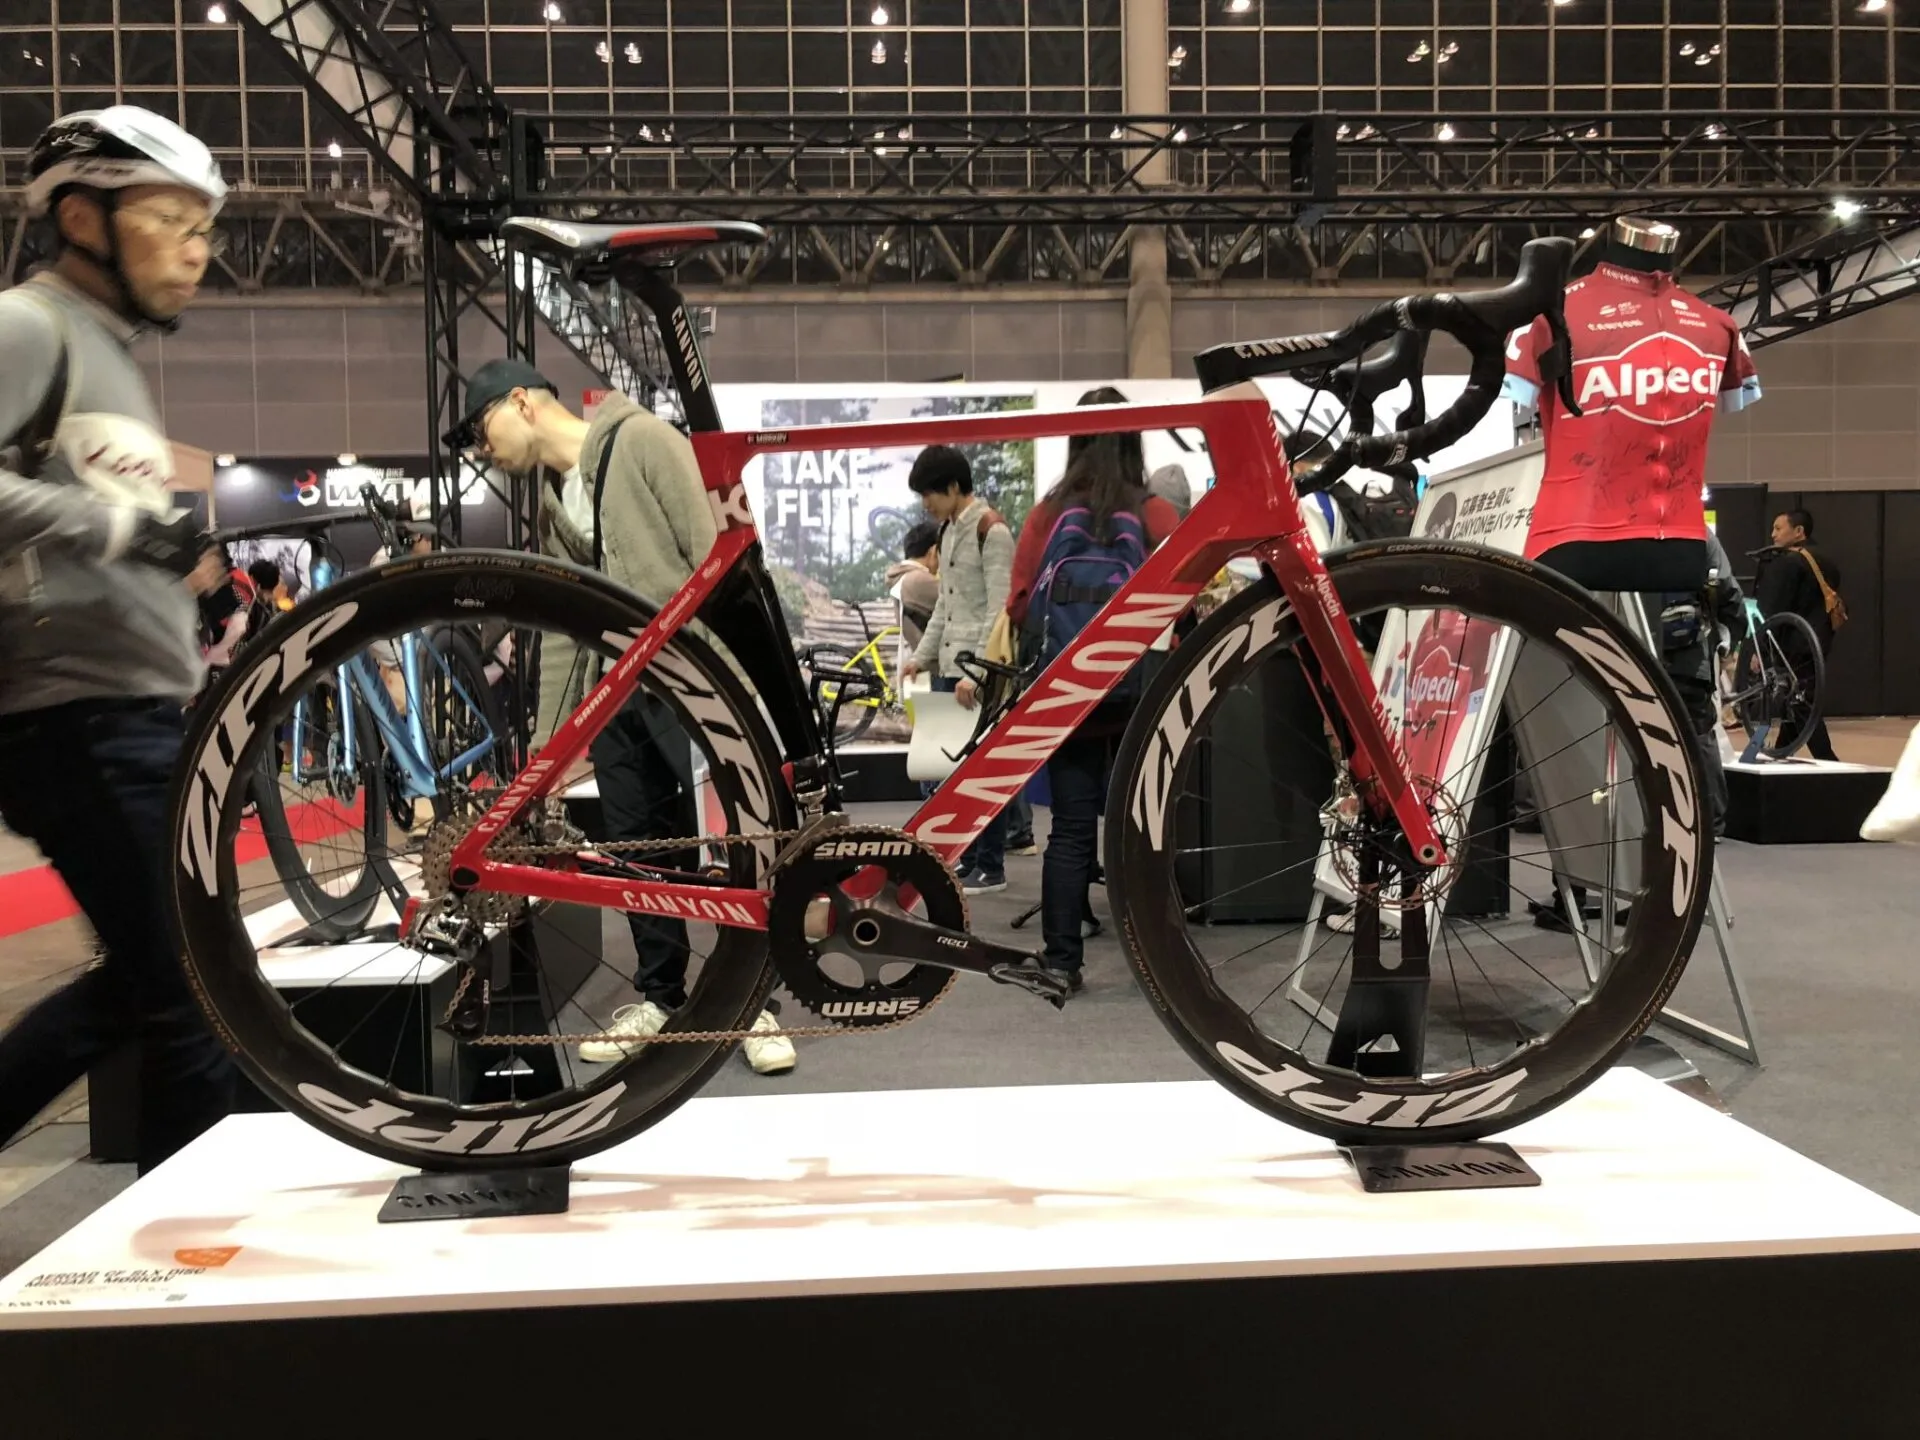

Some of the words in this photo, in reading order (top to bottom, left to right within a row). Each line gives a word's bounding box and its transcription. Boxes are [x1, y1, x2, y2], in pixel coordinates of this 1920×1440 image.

[671, 305, 705, 393] CANYON
[1233, 335, 1330, 359] CANYON
[1313, 573, 1340, 618] Alpecin
[574, 684, 612, 729] SRAM
[916, 593, 1195, 845] CANYON
[181, 601, 359, 897] ZIPP
[1555, 626, 1696, 917] ZIPP
[477, 760, 554, 833] CANYON
[813, 841, 913, 857] SRAM
[622, 890, 757, 925] CANYON
[821, 1000, 920, 1017] SRAM
[1216, 1040, 1528, 1128] ZIPP
[298, 1080, 627, 1154] ZIPP
[1366, 1161, 1526, 1180] CANYON
